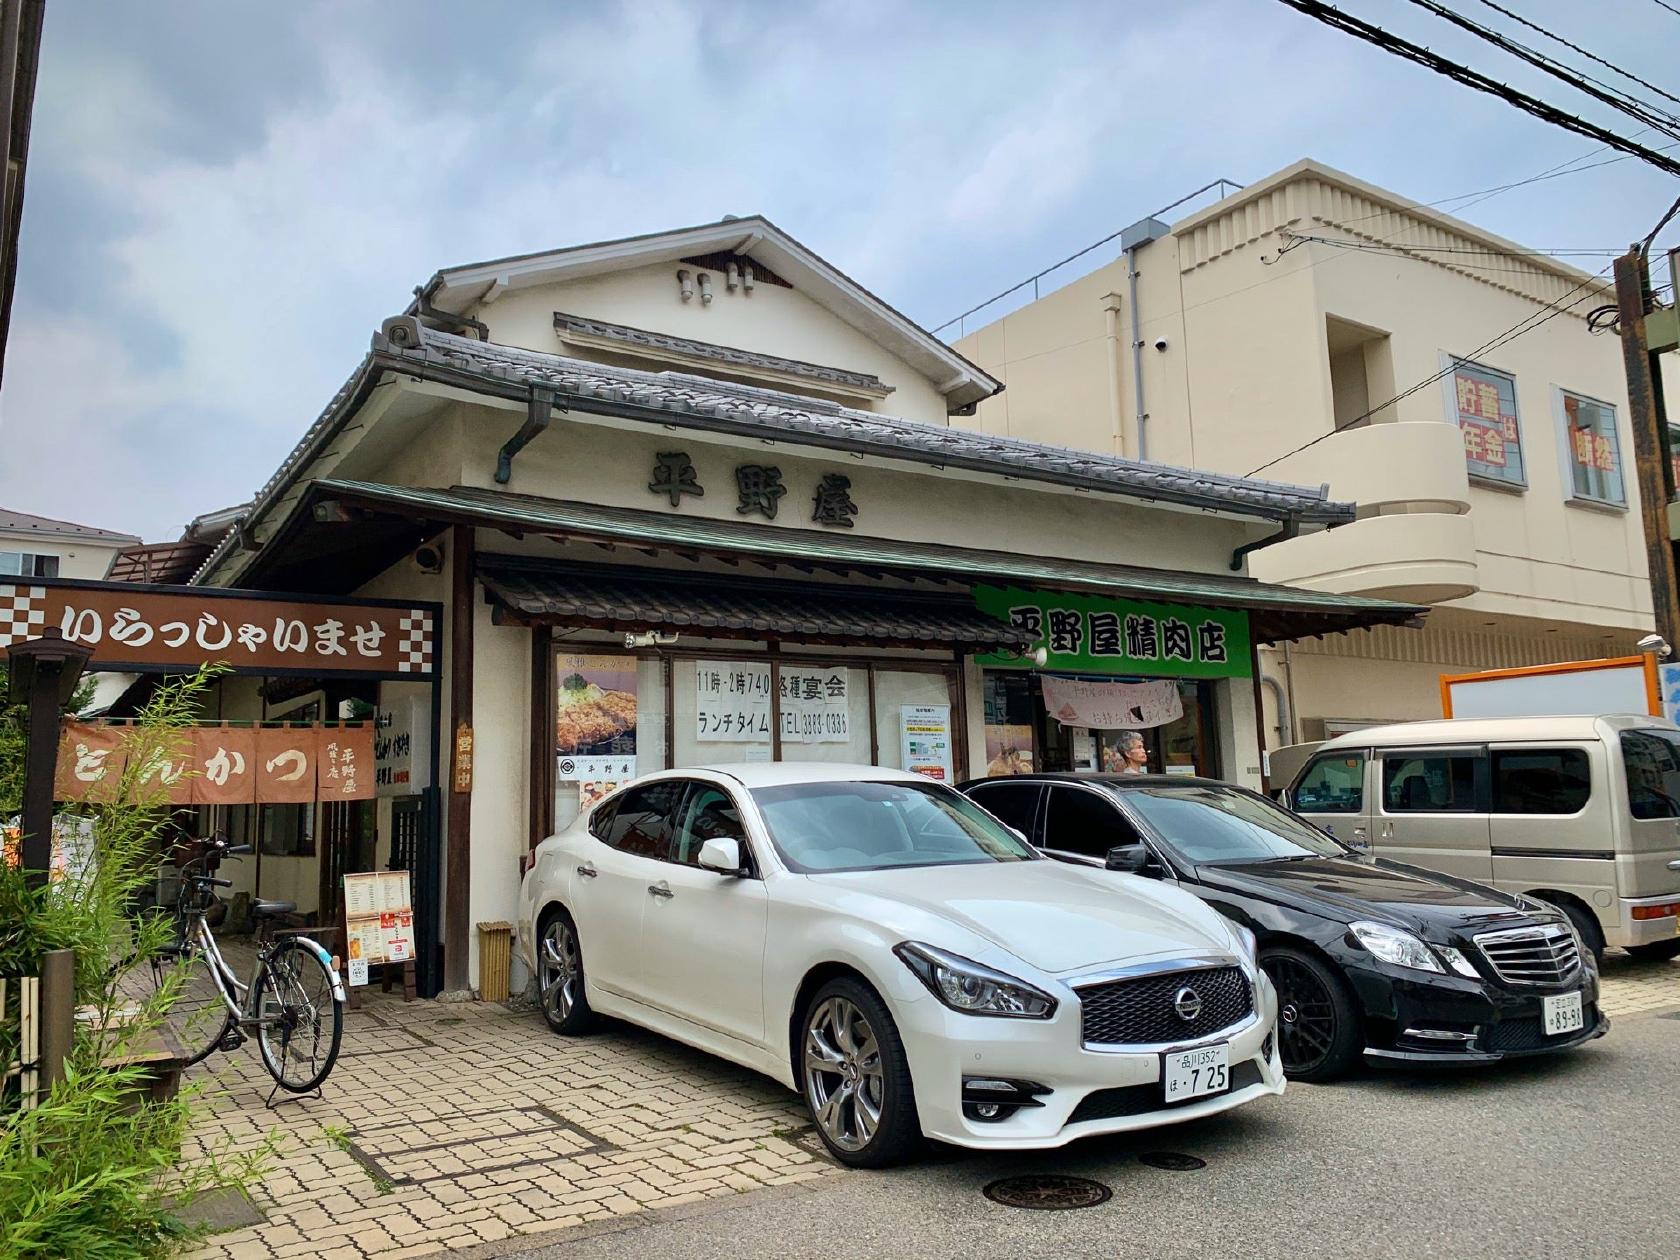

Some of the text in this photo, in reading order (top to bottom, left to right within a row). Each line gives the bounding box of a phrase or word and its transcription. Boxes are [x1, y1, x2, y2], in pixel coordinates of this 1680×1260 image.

[1456, 377, 1500, 421] 貯蓄
[648, 451, 859, 528] 平野屋
[60, 605, 386, 657] いらっしゃいませ
[1009, 605, 1228, 663] 平野屋精肉店
[778, 674, 846, 700] 各種宴会
[698, 711, 769, 734] ランチタイム
[779, 712, 801, 734] TEL
[74, 743, 307, 786] とんかつ
[340, 748, 357, 793] 平野屋
[457, 736, 473, 787] 営業中
[1181, 1050, 1216, 1069] 品川352
